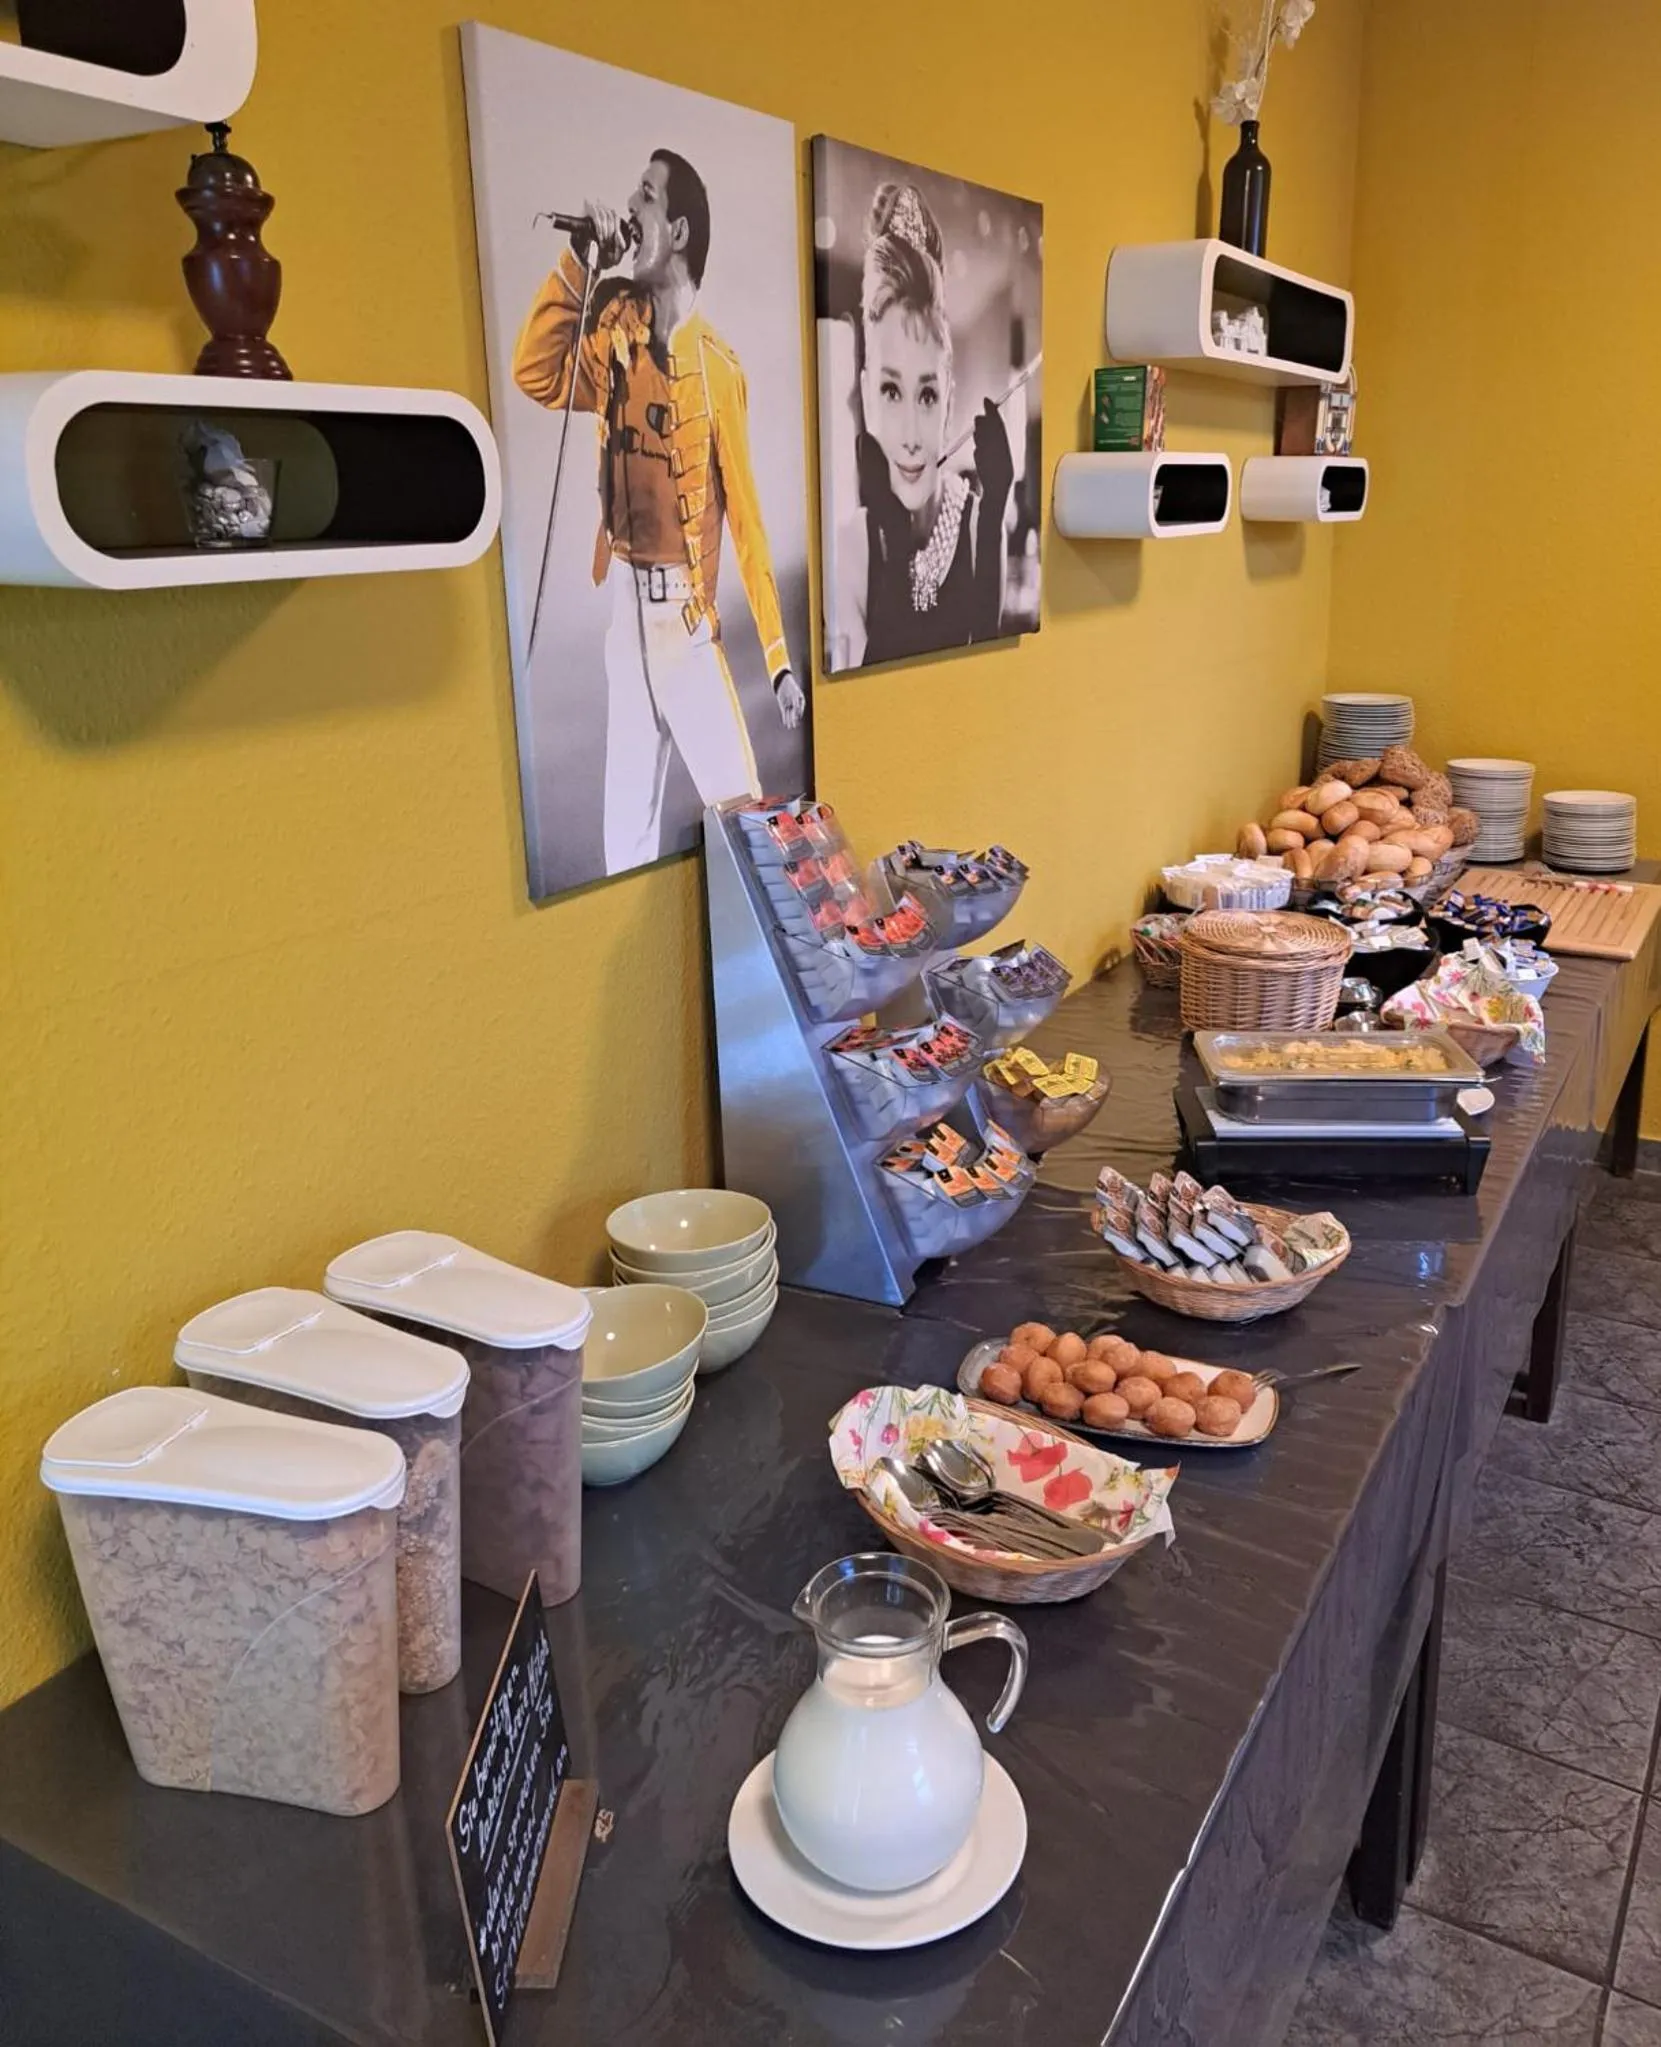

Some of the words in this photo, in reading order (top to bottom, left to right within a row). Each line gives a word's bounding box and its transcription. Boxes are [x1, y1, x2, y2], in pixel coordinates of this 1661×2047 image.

[556, 1744, 568, 1776] an
[458, 1797, 479, 1855] Sie
[485, 1854, 510, 1933] dann
[507, 1742, 542, 1855] sprechen
